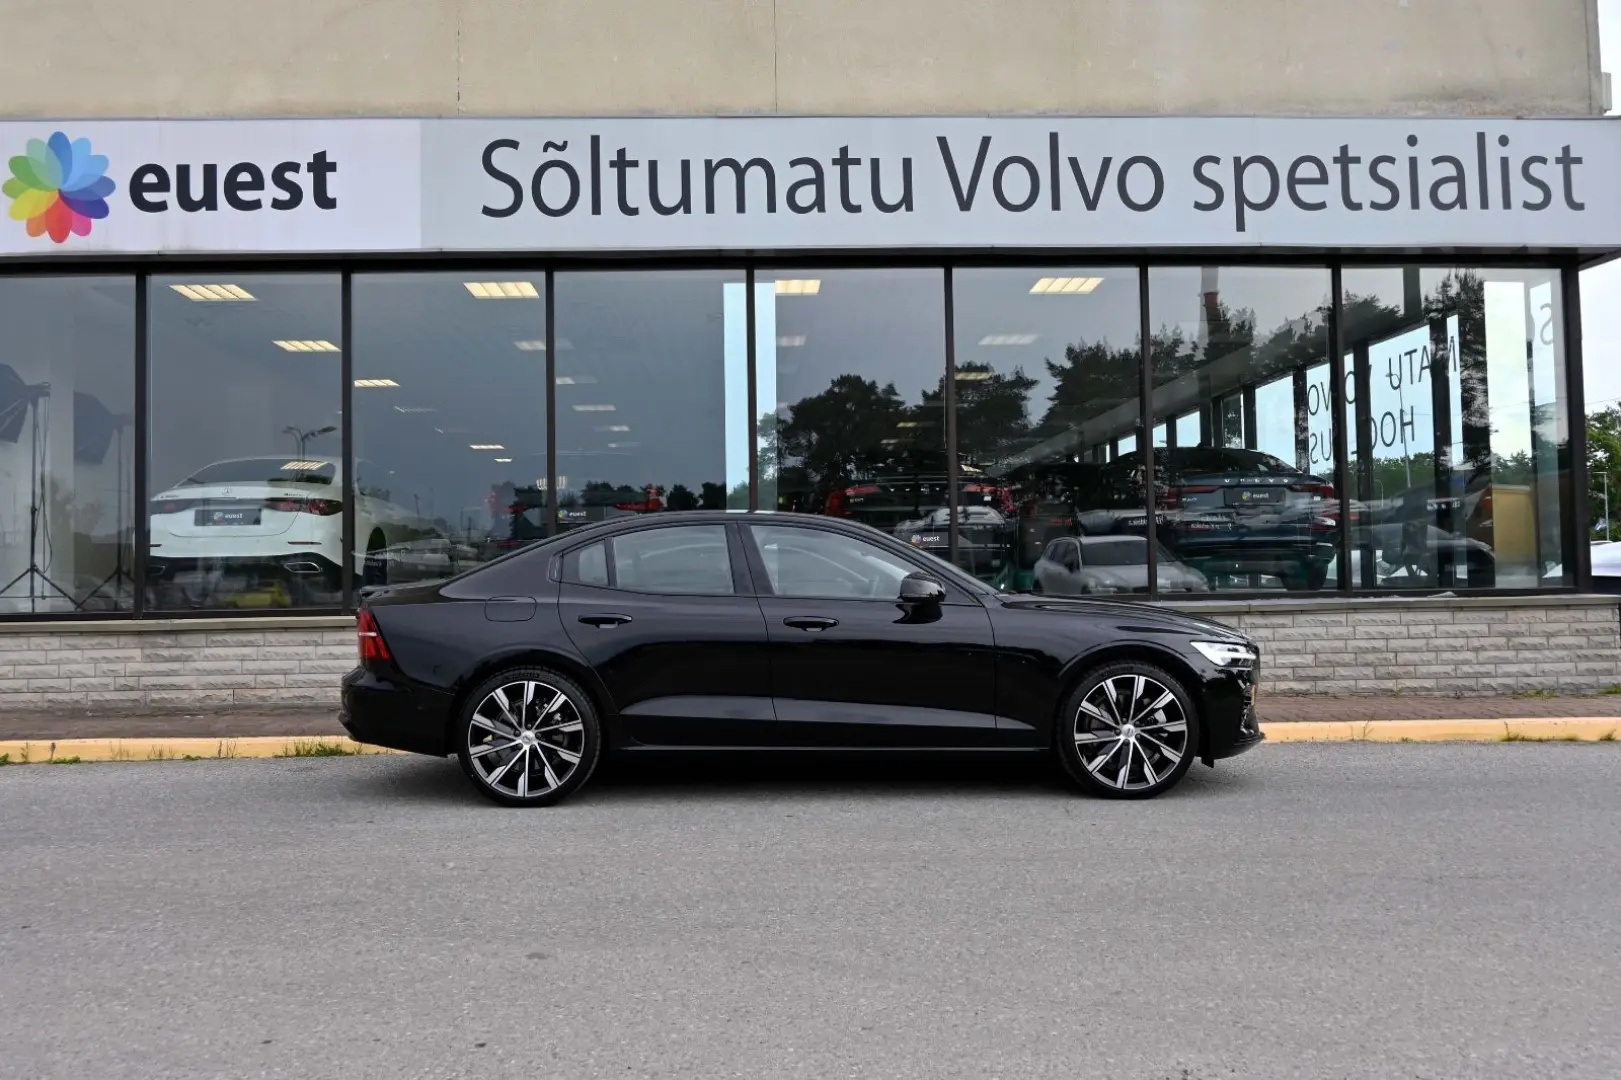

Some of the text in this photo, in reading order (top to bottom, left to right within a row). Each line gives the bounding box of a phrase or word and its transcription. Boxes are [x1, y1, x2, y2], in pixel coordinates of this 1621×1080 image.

[129, 150, 337, 213] euest
[481, 131, 1585, 232] Sõltumatu Volvo spetsialist
